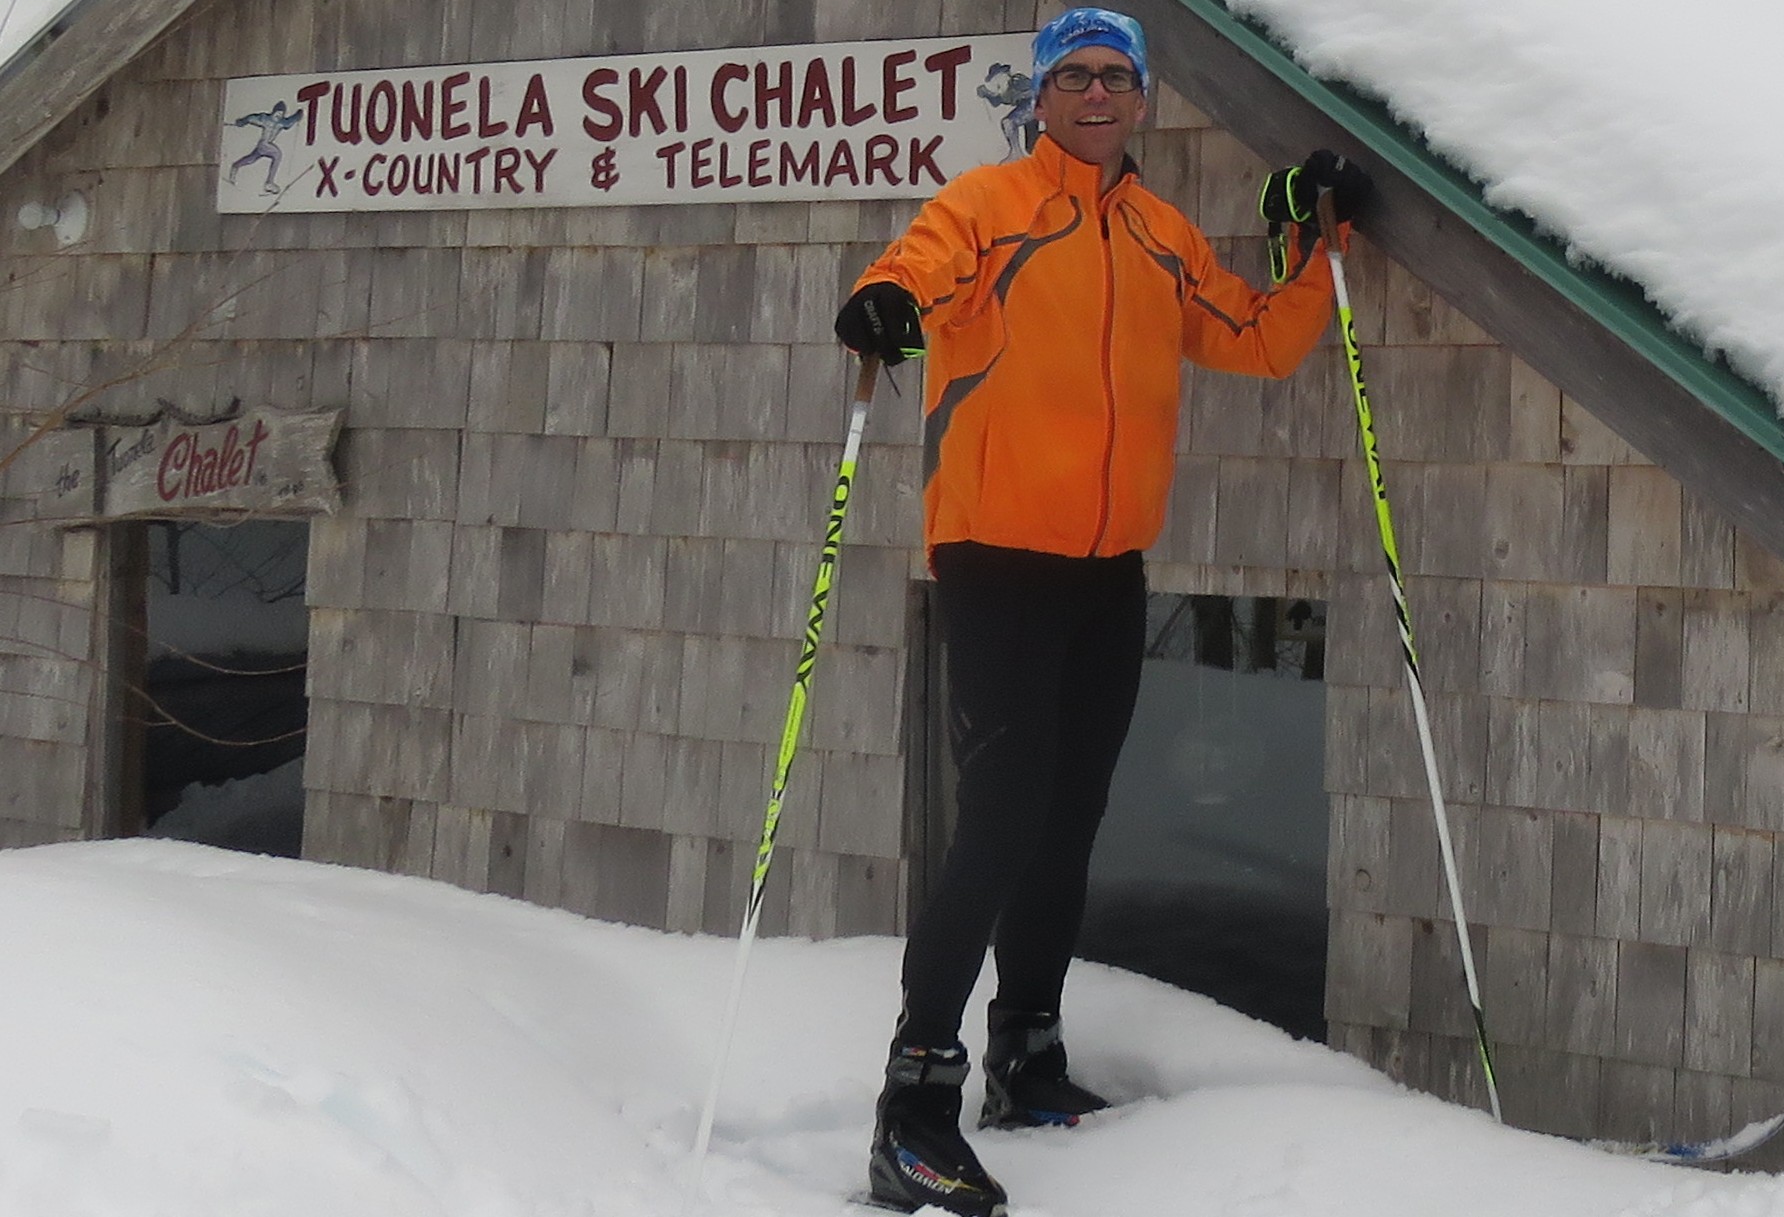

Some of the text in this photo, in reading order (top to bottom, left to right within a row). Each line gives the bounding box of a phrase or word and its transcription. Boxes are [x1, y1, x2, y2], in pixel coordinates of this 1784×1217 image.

[297, 45, 972, 146] TUONELA SKI CHALET
[315, 134, 948, 198] X-COUNTRY & TELEMARK
[157, 419, 269, 502] Chalet
